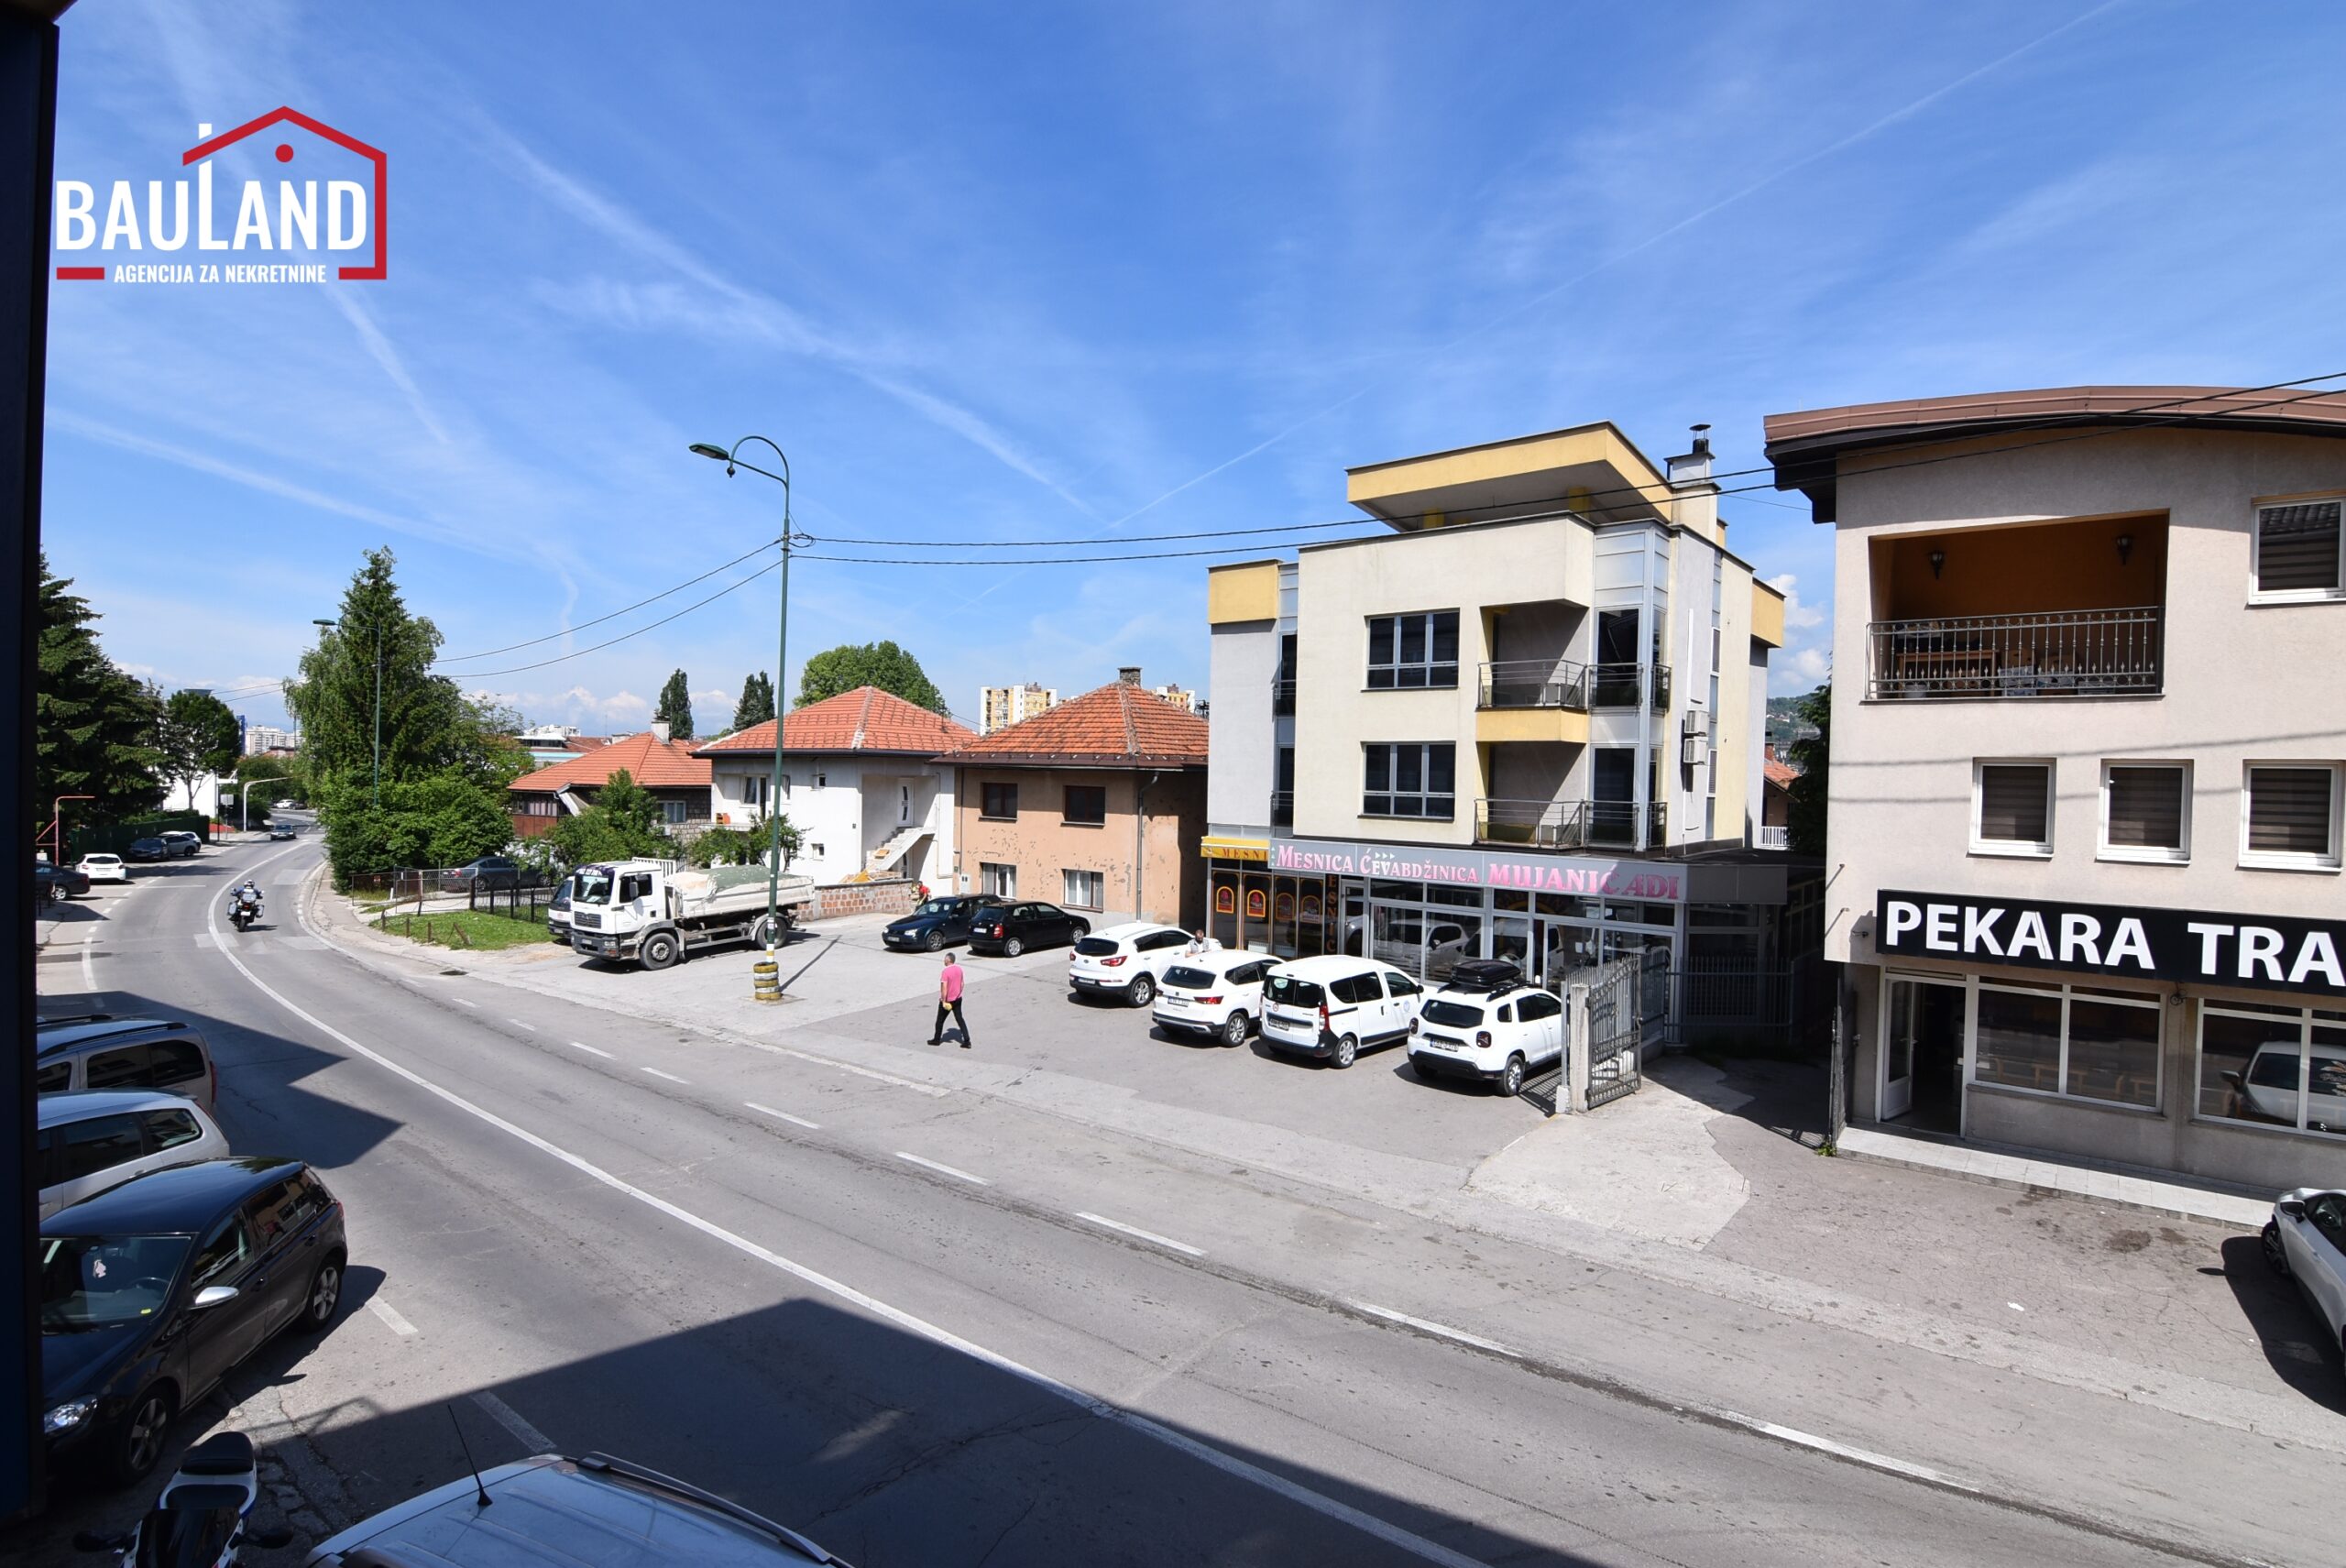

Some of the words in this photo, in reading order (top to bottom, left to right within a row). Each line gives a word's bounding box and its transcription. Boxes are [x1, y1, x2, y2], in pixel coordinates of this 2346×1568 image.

[1276, 845, 1354, 872] MESNICA
[1487, 863, 1619, 894] MUJANIĆ
[1621, 873, 1680, 900] ADI
[1886, 901, 2155, 970] PEKARA
[2187, 922, 2346, 987] TRA
